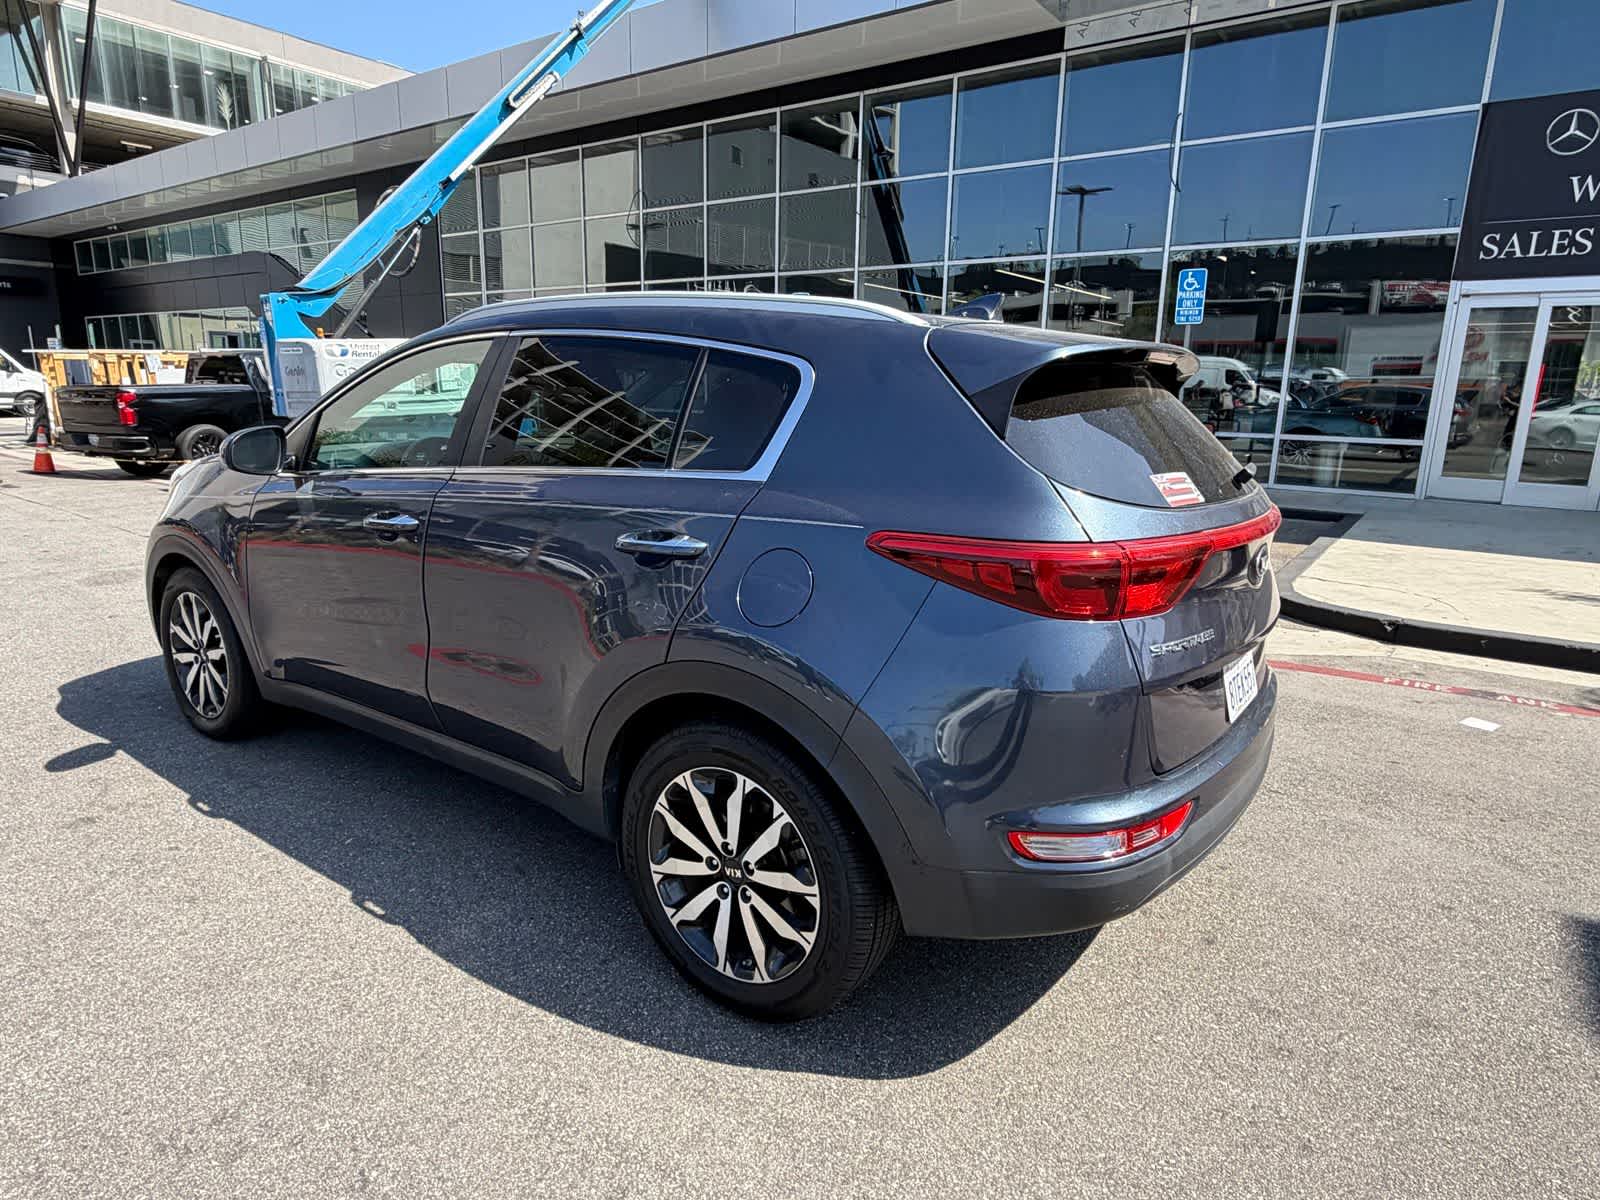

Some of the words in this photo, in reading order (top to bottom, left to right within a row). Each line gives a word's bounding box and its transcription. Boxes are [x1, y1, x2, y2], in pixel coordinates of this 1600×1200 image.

[1479, 227, 1595, 260] SALES
[1178, 291, 1204, 299] PARKING
[1182, 299, 1198, 308] ONLY
[1383, 677, 1452, 692] FIRE
[724, 865, 742, 879] KIA
